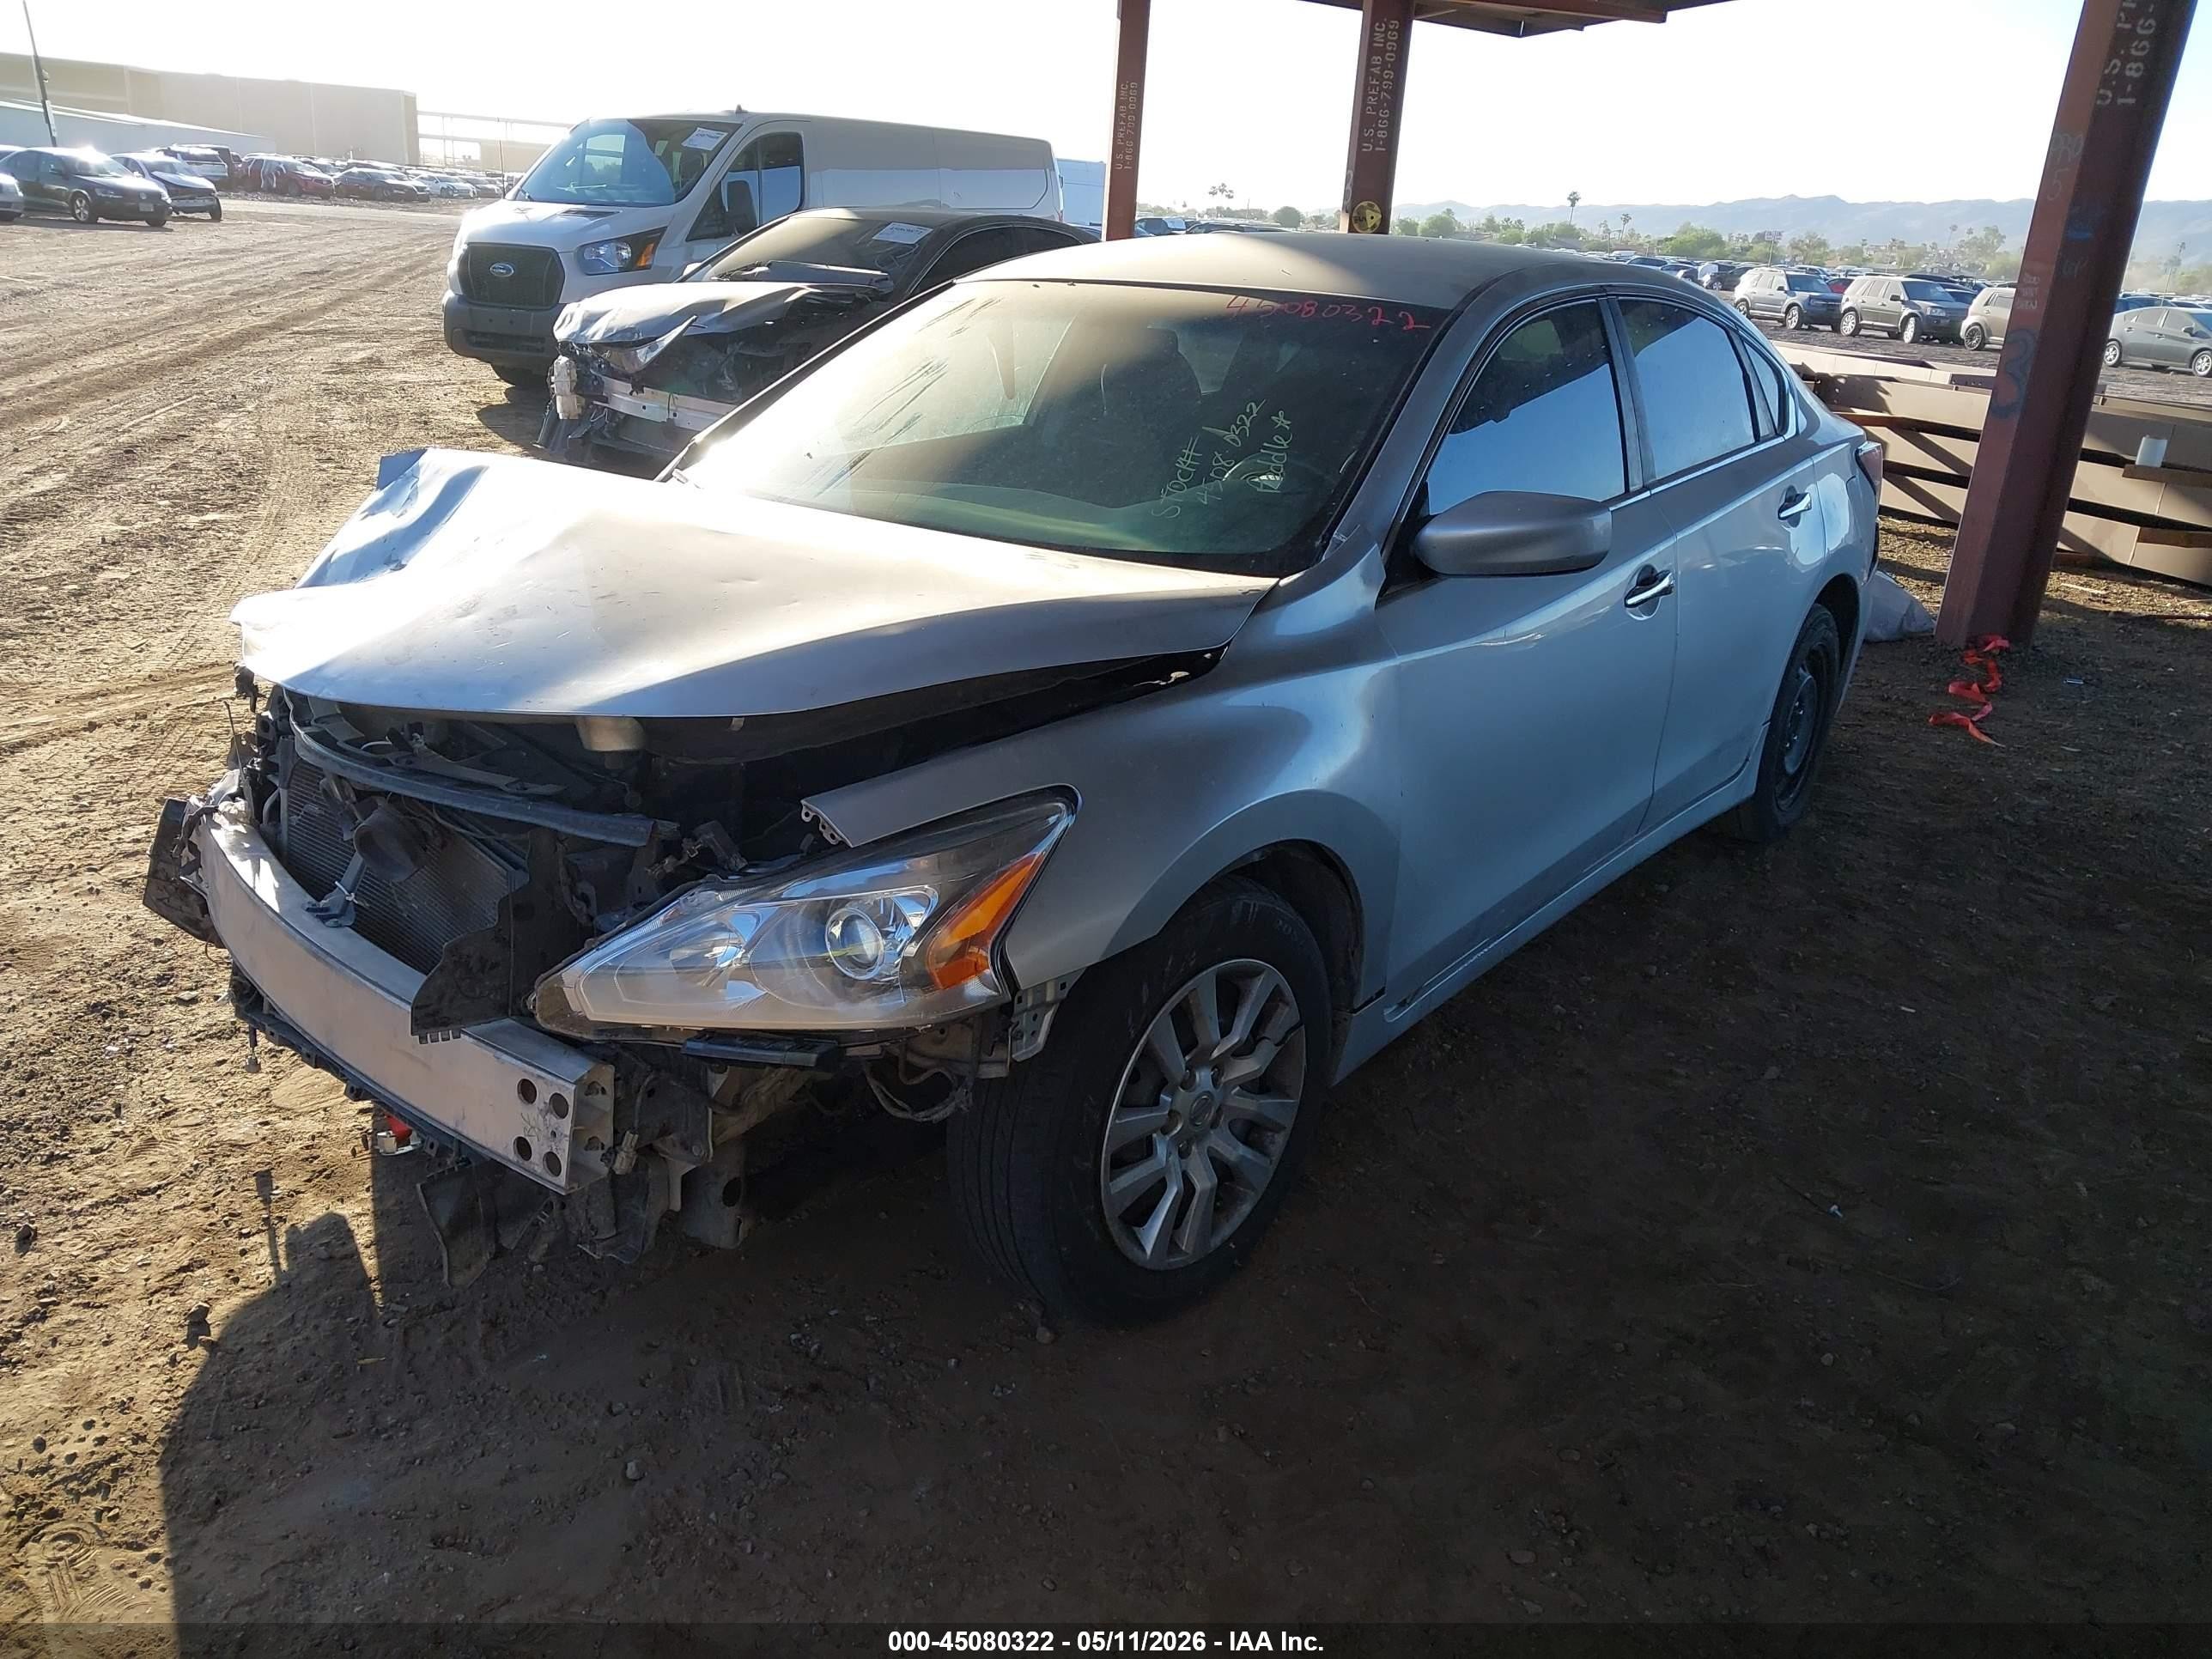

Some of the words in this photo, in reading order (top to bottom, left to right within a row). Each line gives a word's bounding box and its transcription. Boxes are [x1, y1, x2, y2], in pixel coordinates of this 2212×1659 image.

[1374, 17, 1388, 47] INC.
[1366, 56, 1382, 115] PREFAB
[1375, 20, 1401, 151] 1-866-799-0969
[2096, 50, 2125, 106] U.S.
[1117, 106, 1127, 145] PREFAB
[1362, 124, 1376, 152] U.S.
[1115, 151, 1124, 170] U.S.
[1225, 295, 1431, 331] 45080322
